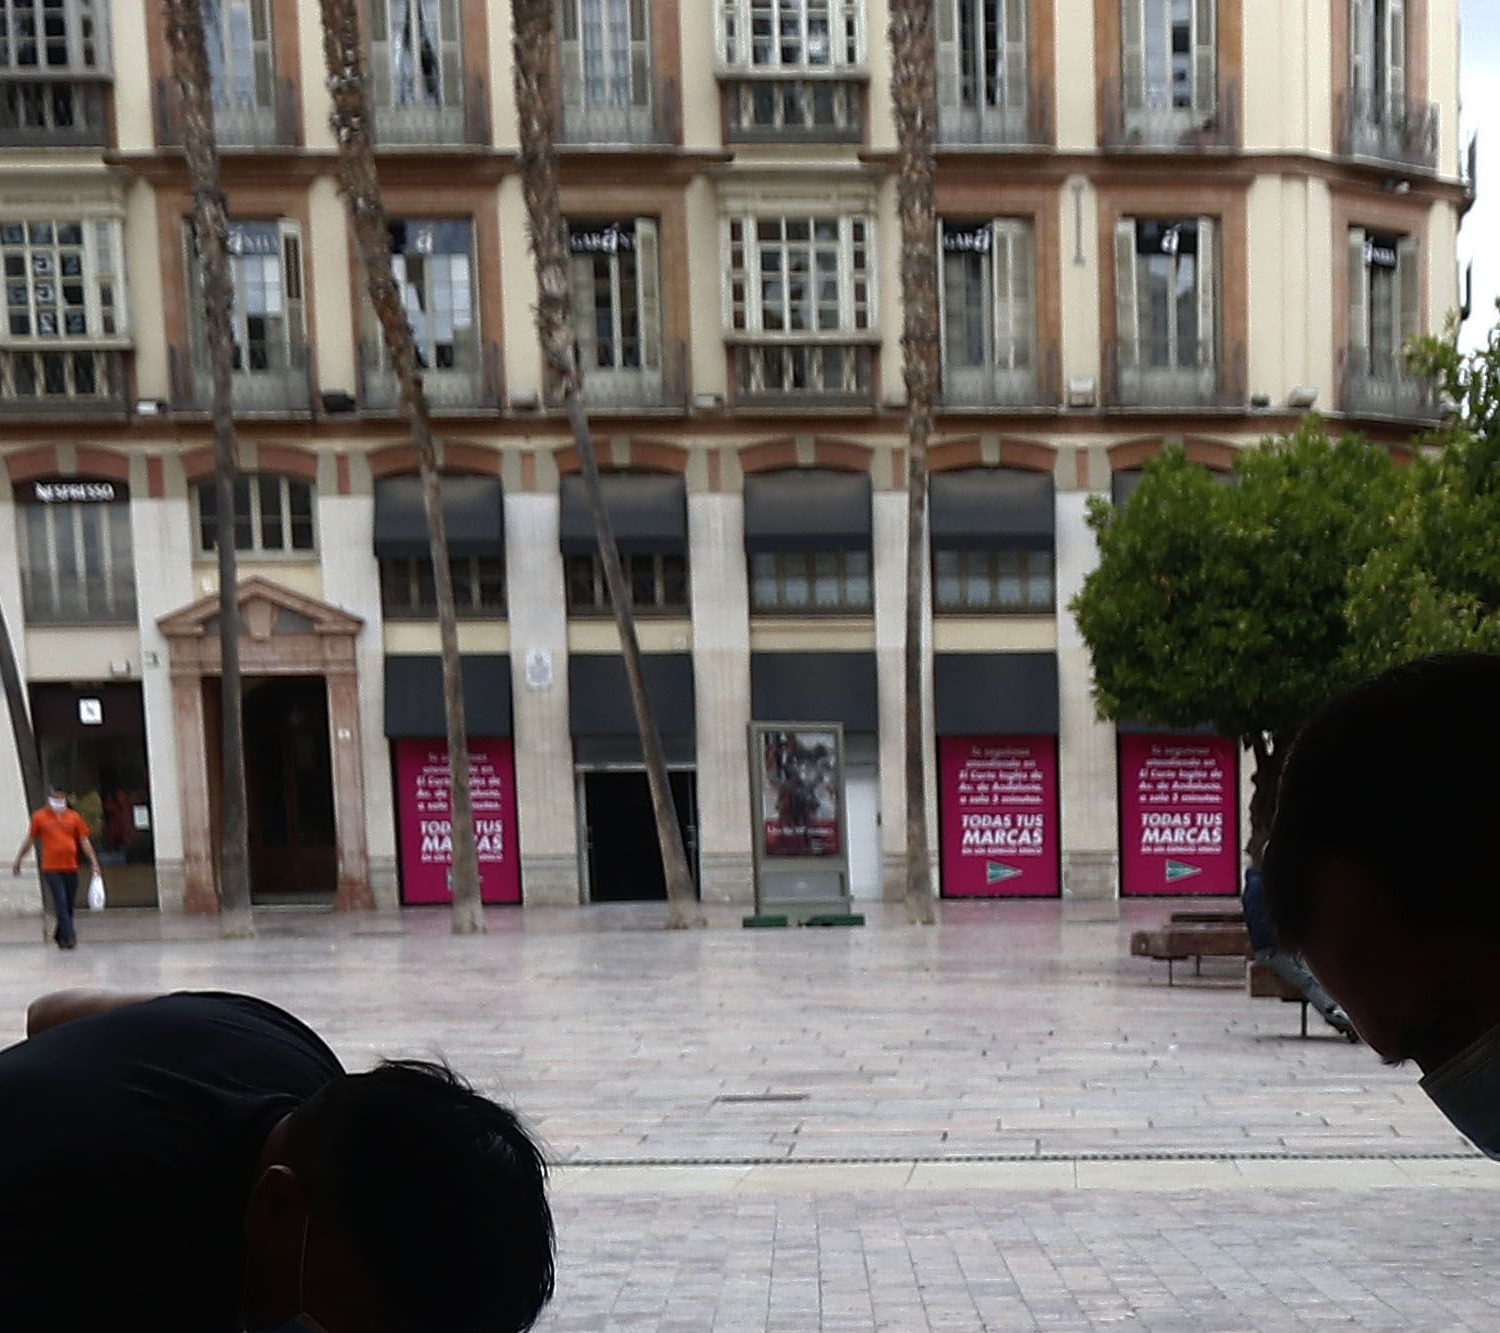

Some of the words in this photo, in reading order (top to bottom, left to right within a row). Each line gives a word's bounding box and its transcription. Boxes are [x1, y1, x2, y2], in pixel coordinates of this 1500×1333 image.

[35, 482, 114, 504] NESPRESSO
[475, 820, 503, 834] TUS
[961, 814, 1012, 828] TODAS
[1016, 814, 1044, 828] TUS
[1141, 812, 1192, 826] TODAS
[1195, 812, 1223, 825] TUS
[421, 834, 503, 851] MAAS
[962, 828, 1044, 845] MARCAS
[1141, 826, 1222, 843] MARCAS
